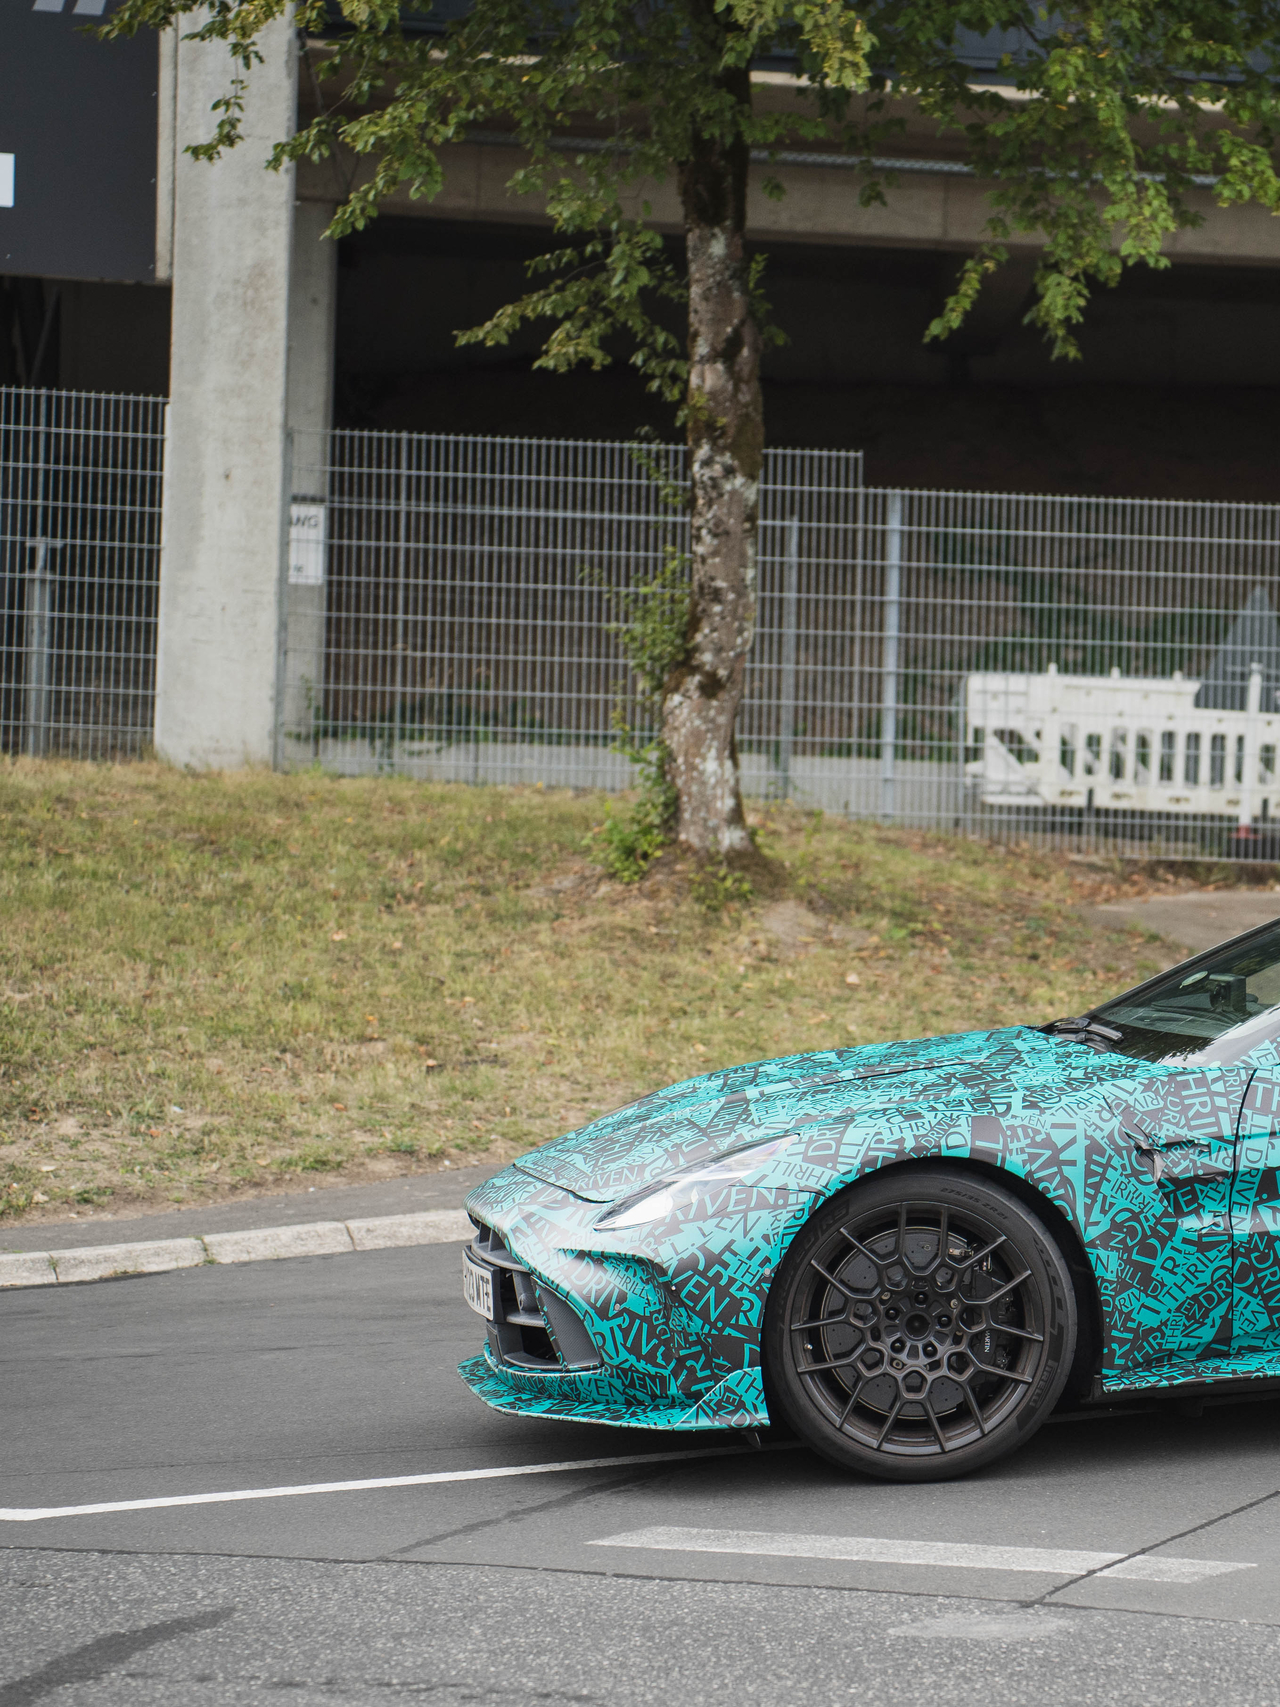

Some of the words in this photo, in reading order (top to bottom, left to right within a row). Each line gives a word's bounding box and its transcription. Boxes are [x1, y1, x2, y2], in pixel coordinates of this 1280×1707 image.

[572, 1258, 619, 1317] DRIV
[1164, 1312, 1184, 1349] THRI
[603, 1366, 667, 1398] RIVEN.
